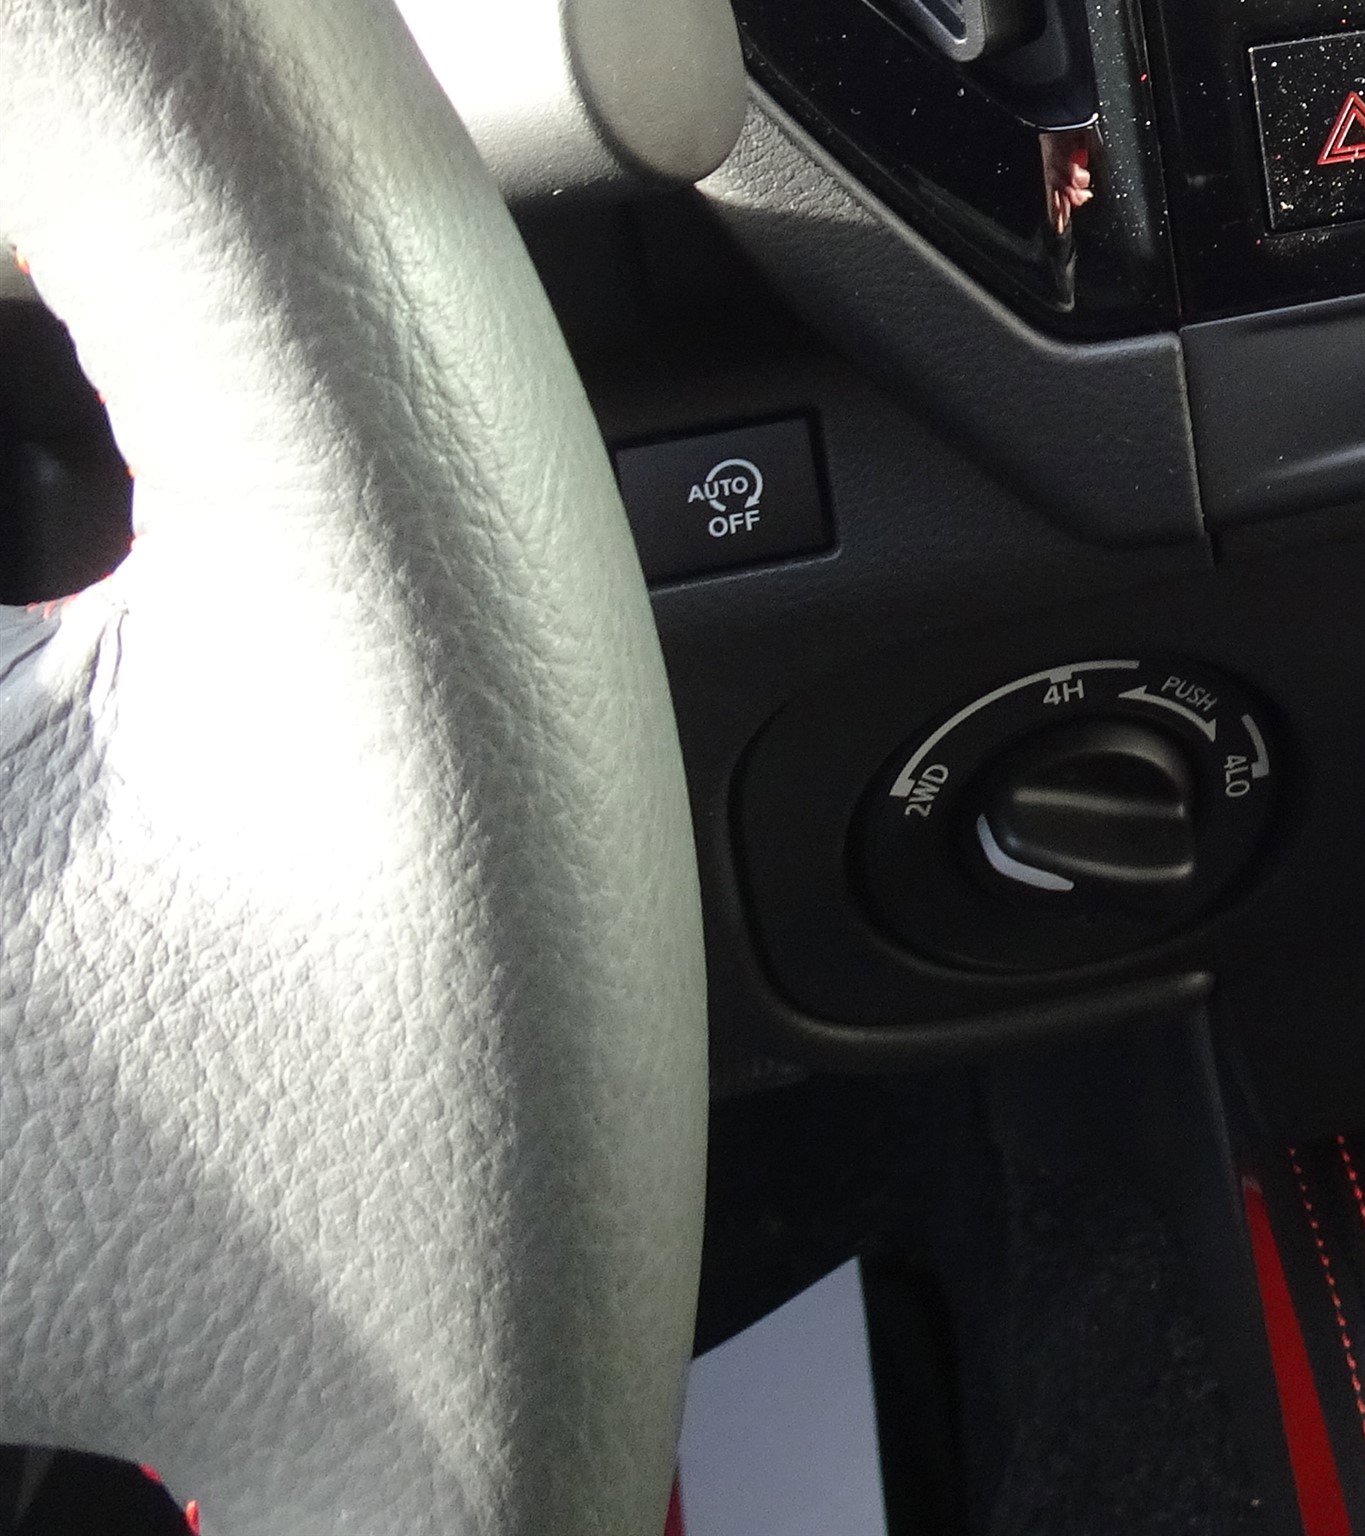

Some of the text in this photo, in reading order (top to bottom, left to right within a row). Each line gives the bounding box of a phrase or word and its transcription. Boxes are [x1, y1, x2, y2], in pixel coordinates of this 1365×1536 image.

[687, 476, 749, 504] AUTO
[708, 510, 761, 538] OFF
[1042, 679, 1085, 706] 4H
[1160, 675, 1218, 713] PUSH
[904, 763, 950, 818] 2WD
[1223, 753, 1250, 799] 4LO
